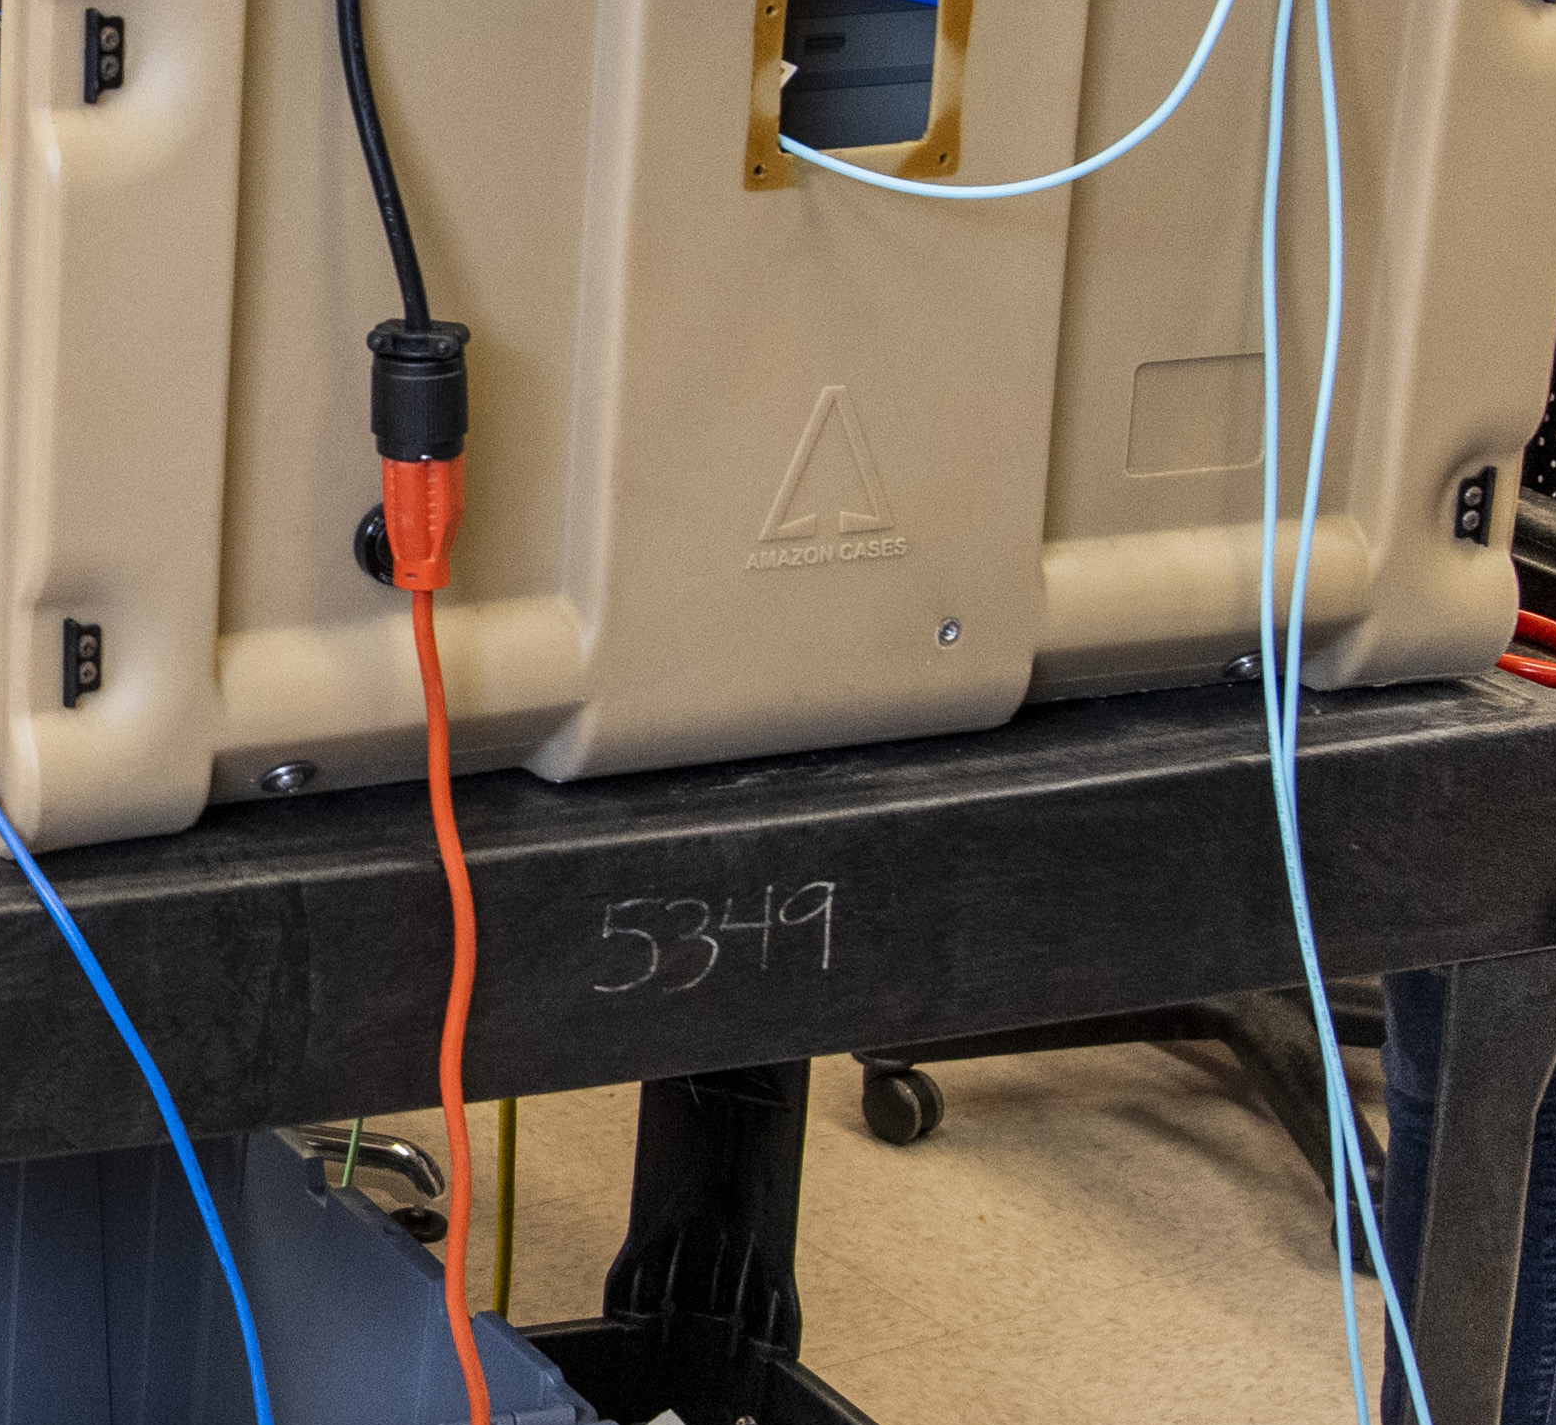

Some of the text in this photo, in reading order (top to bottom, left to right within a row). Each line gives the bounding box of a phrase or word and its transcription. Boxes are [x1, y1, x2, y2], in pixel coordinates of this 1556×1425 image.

[745, 537, 908, 570] AMAZON CASES
[593, 880, 836, 995] 5349
